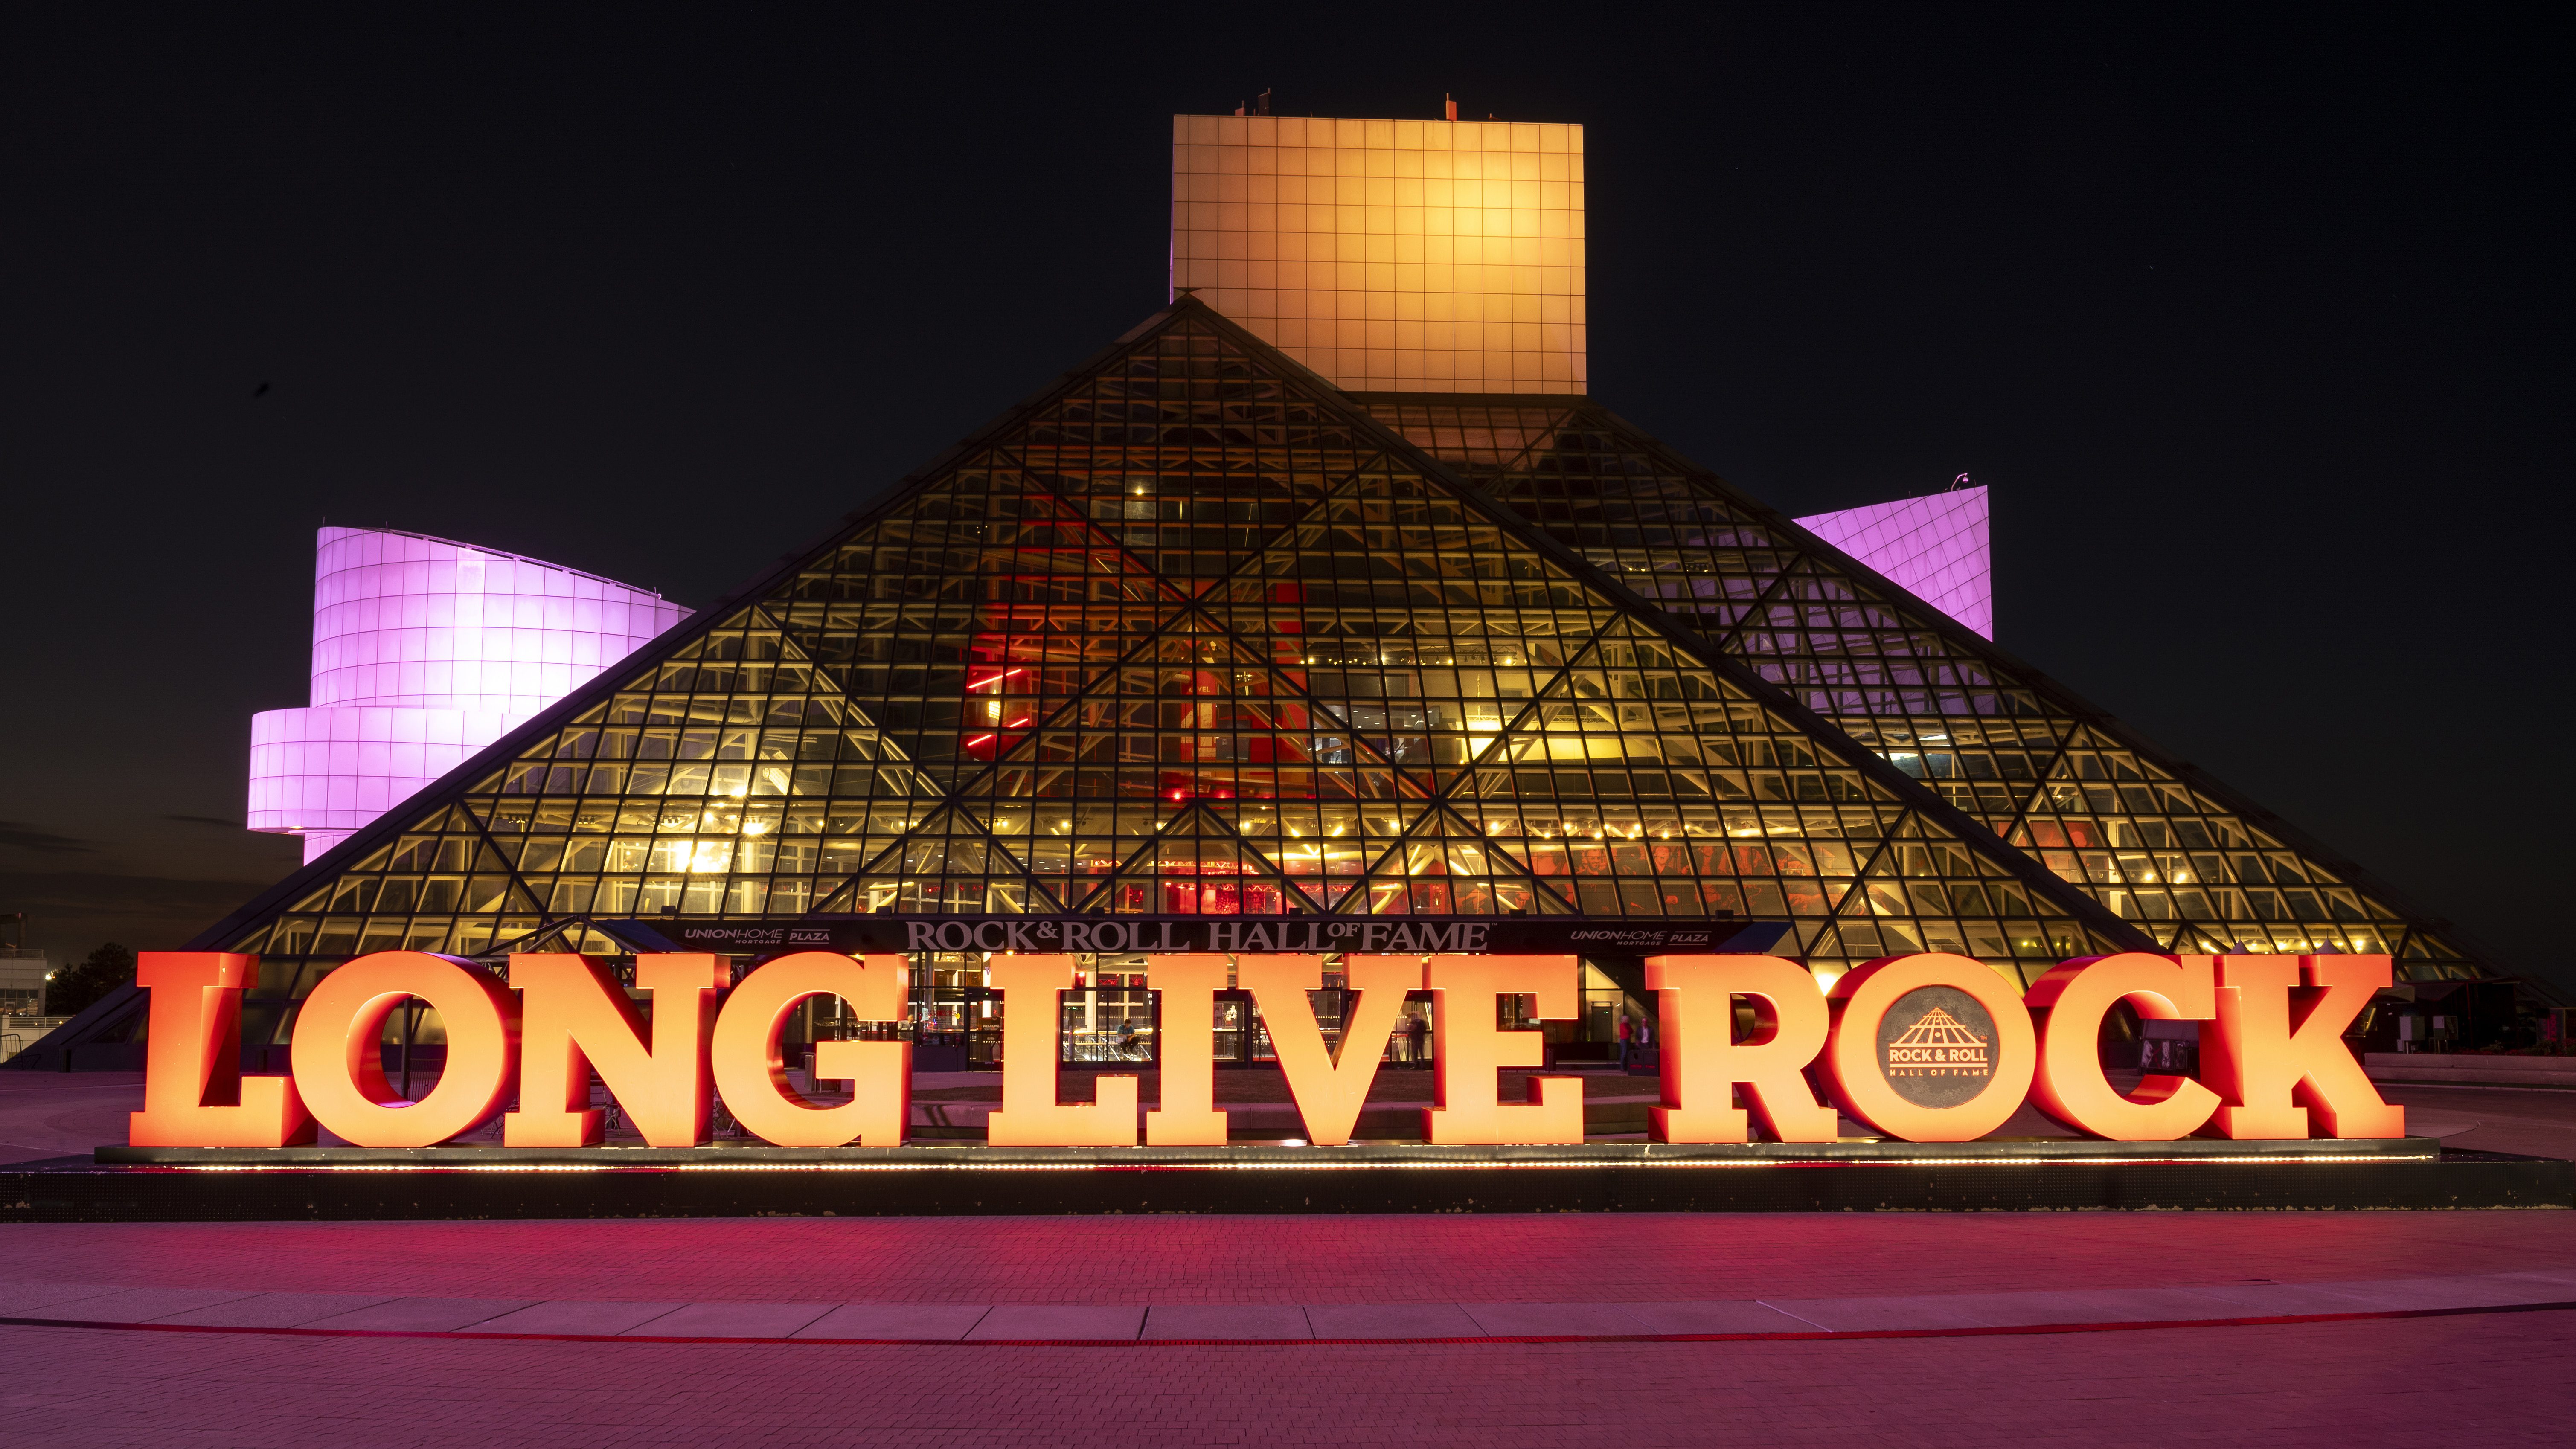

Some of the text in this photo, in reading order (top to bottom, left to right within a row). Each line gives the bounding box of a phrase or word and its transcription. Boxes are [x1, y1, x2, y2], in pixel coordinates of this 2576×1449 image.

[789, 932, 830, 941] PLAZA
[1207, 922, 1336, 951] HALL
[1327, 923, 1361, 937] OF
[1360, 922, 1490, 951] FAME
[1669, 934, 1709, 942] PLAZA
[130, 951, 2405, 1147] LONG LIVE ROCK
[1889, 1049, 1988, 1062] ROCK & ROLL
